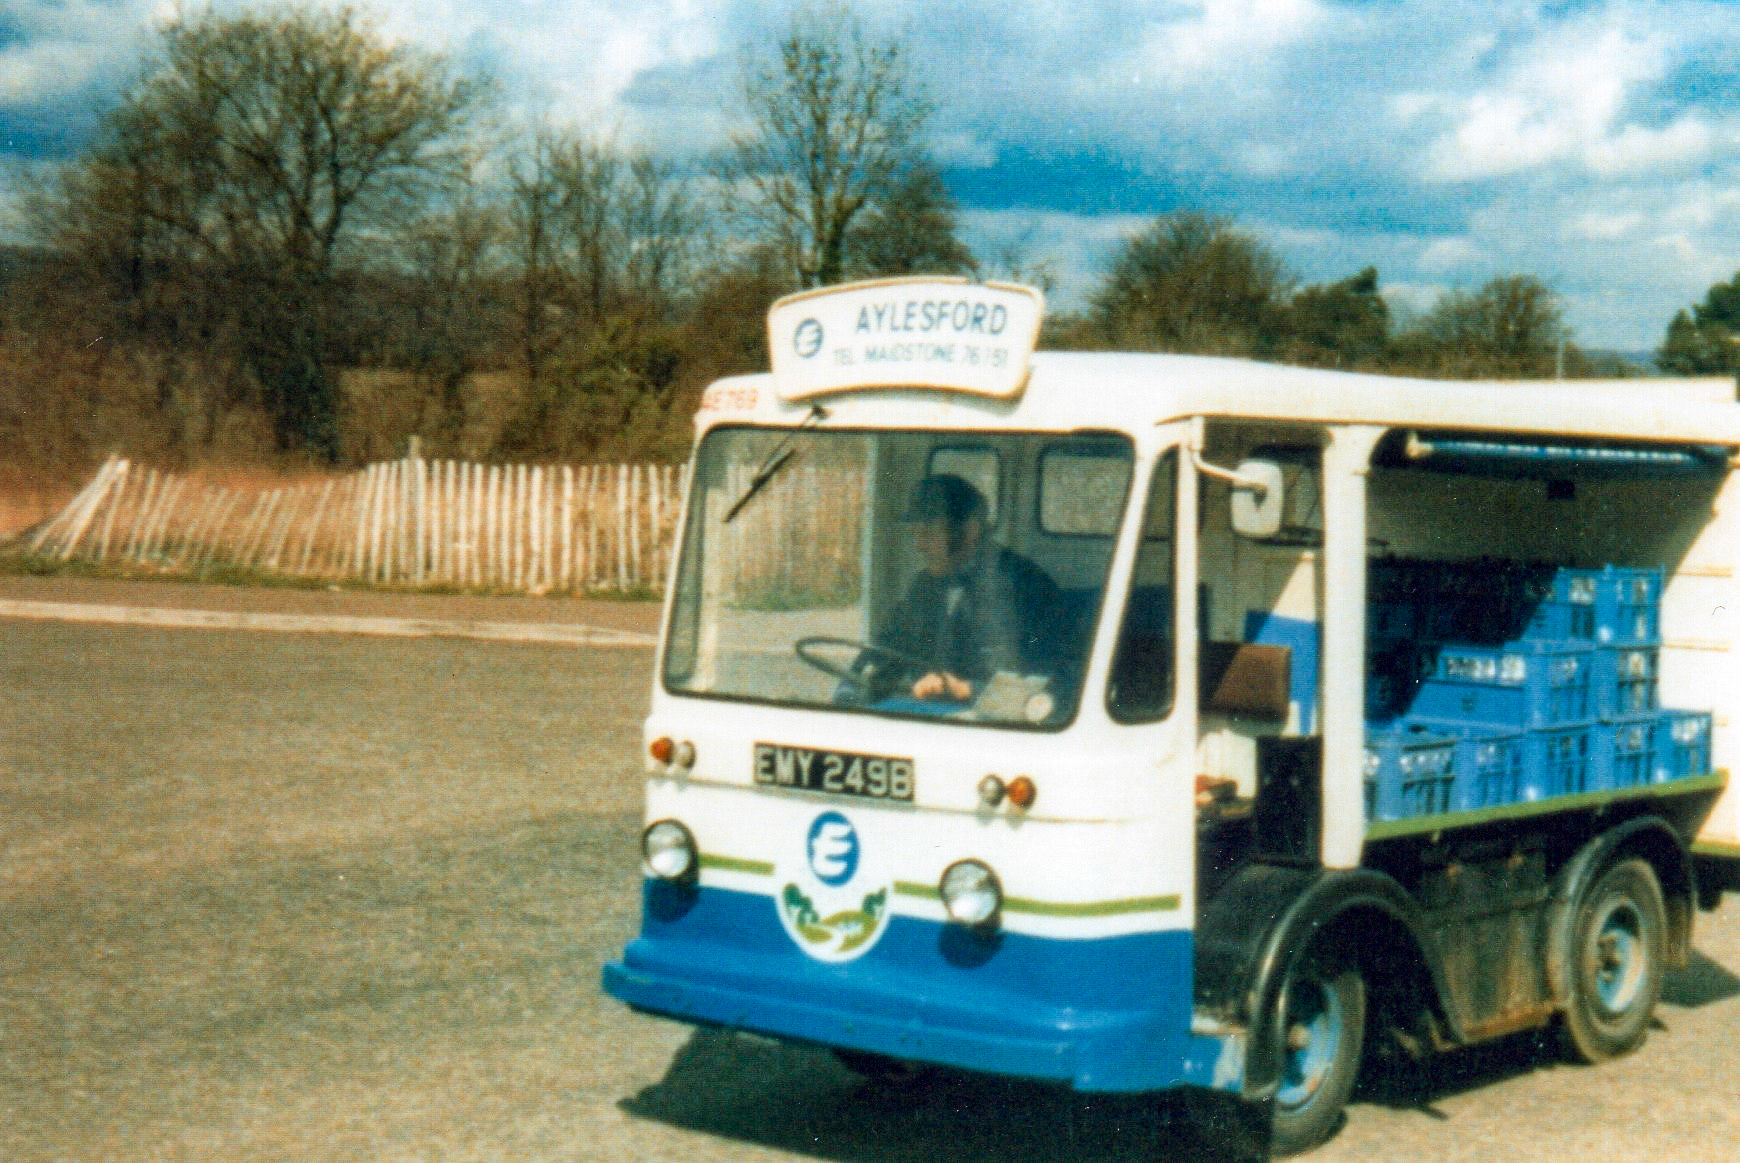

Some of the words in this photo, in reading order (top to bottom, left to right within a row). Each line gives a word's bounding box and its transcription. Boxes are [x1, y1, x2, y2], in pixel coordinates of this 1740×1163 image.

[856, 300, 1007, 335] AYLESFORD
[864, 342, 954, 363] MAIDSTONE
[755, 747, 814, 787] EMY
[822, 754, 912, 799] 249B
